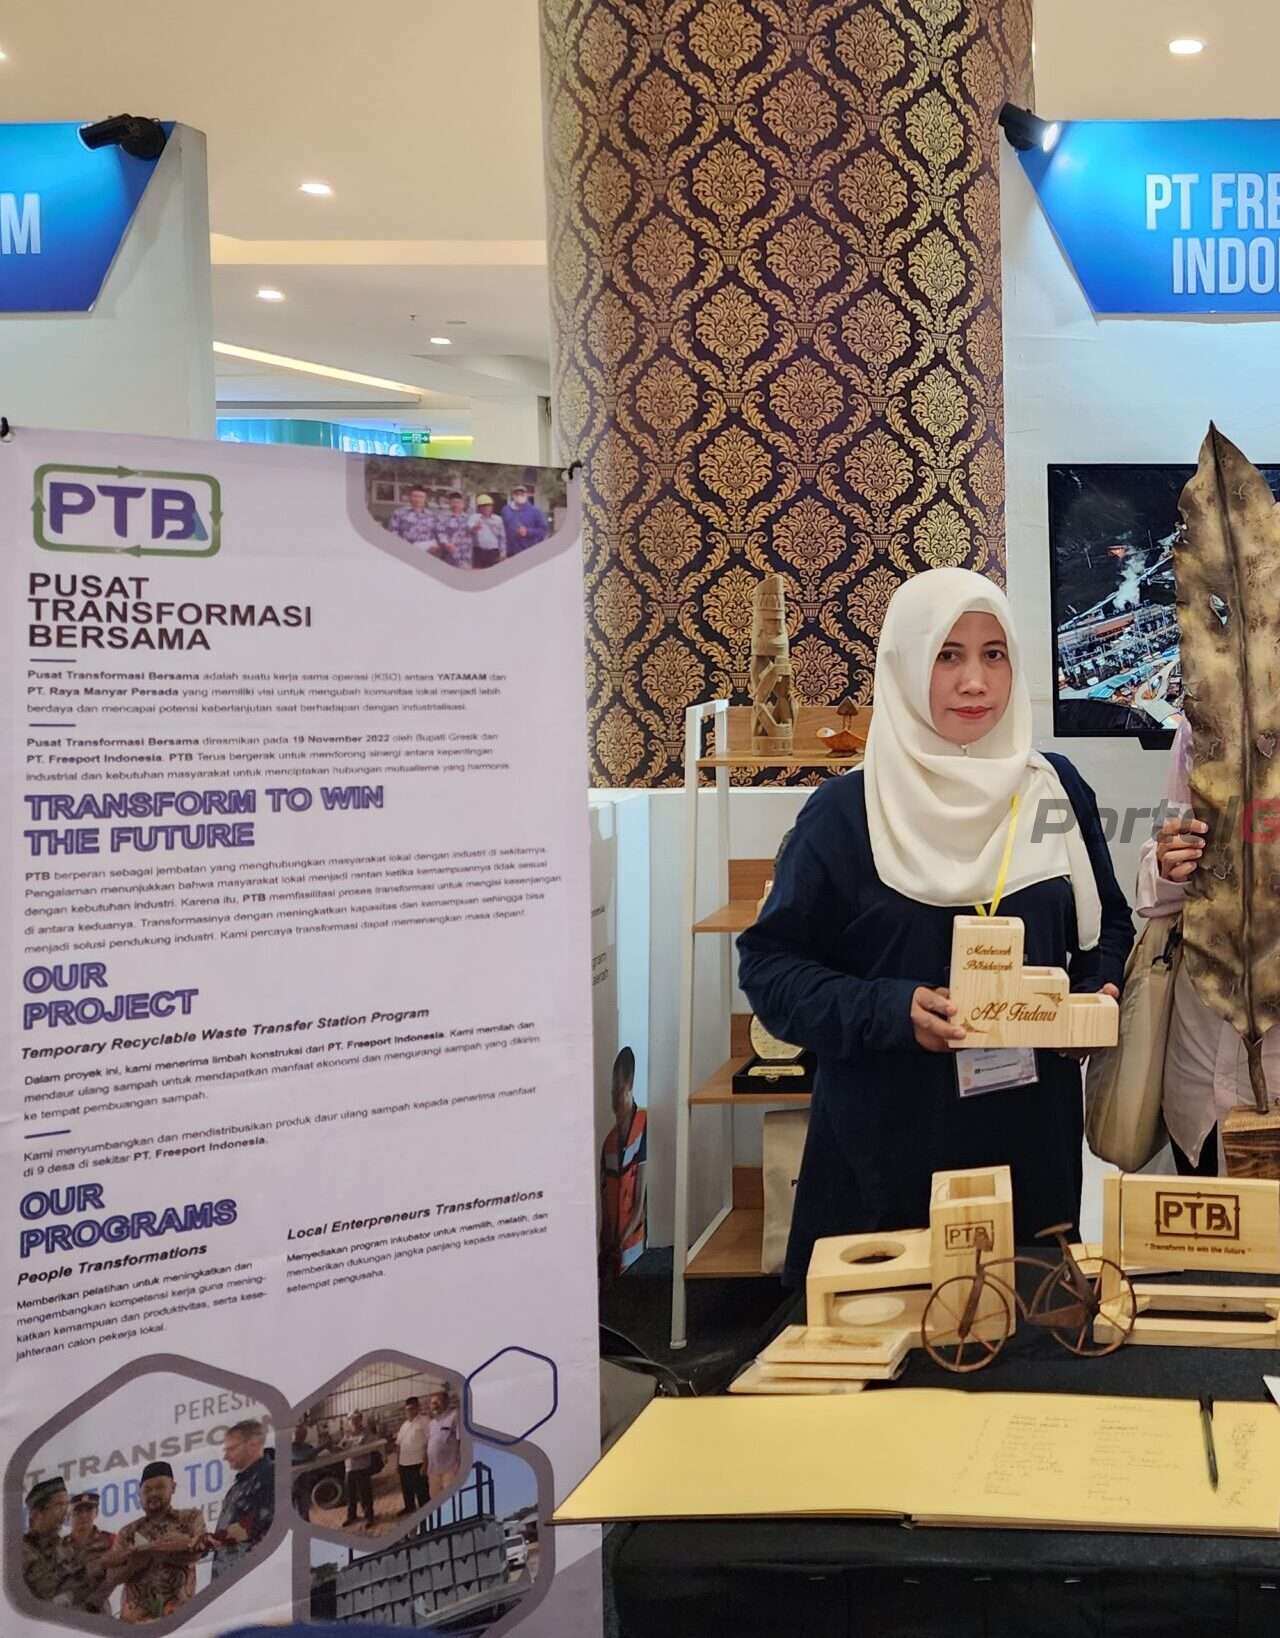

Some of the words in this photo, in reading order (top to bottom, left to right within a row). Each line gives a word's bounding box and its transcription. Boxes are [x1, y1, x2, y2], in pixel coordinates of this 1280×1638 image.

[1146, 173, 1199, 231] PT
[48, 481, 208, 541] PTB
[28, 573, 150, 599] PUSAT
[28, 598, 313, 628] TRANSFORMASI
[28, 625, 211, 651] BERSAMA
[27, 670, 63, 679] Pusat
[67, 671, 146, 680] Transformasi
[147, 672, 201, 680] Bersama
[27, 687, 45, 695] PT.
[49, 687, 81, 697] Raya
[83, 688, 128, 697] Manyar
[131, 688, 180, 696] Persada
[26, 755, 44, 763] PT.
[48, 755, 101, 764] Freeport
[103, 754, 165, 763] Indonesia.
[168, 753, 195, 762] PTB
[197, 753, 227, 761] Terus
[24, 790, 257, 821] TRANSFORM
[265, 787, 312, 814] TO
[320, 784, 384, 811] WIN
[24, 827, 100, 856] THE
[110, 822, 256, 854] FUTURE
[25, 872, 52, 881] PTB
[53, 871, 107, 880] berperan
[109, 868, 154, 878] sebagai
[155, 866, 208, 876] jembatan
[209, 864, 237, 874] yang
[23, 961, 108, 995] OUR
[23, 988, 199, 1030] PROJECT
[22, 1042, 108, 1059] Temporary
[111, 1032, 197, 1050] Recyclable
[201, 1027, 248, 1040] Waste
[253, 1020, 313, 1035] Transfer
[317, 1015, 367, 1028] Station
[371, 1009, 430, 1023] Program
[24, 1075, 62, 1085] Dalam
[63, 1069, 103, 1082] proyek
[125, 1065, 153, 1073] kami
[154, 1059, 210, 1070] menerima
[211, 1054, 248, 1064] limbah
[249, 1048, 304, 1059] konstruksi
[305, 1045, 326, 1054] dari
[327, 1042, 344, 1052] PT.
[346, 1038, 393, 1048] Freeport
[20, 1182, 106, 1222] OUR
[287, 1224, 328, 1240] Local
[331, 1209, 431, 1232] Enterpreneurs
[437, 1191, 544, 1214] Transformations
[1162, 1200, 1233, 1232] PTB
[19, 1198, 239, 1260] PROGRAMS
[17, 1266, 74, 1285] People
[79, 1245, 208, 1273] Transformations
[1211, 1245, 1222, 1253] the
